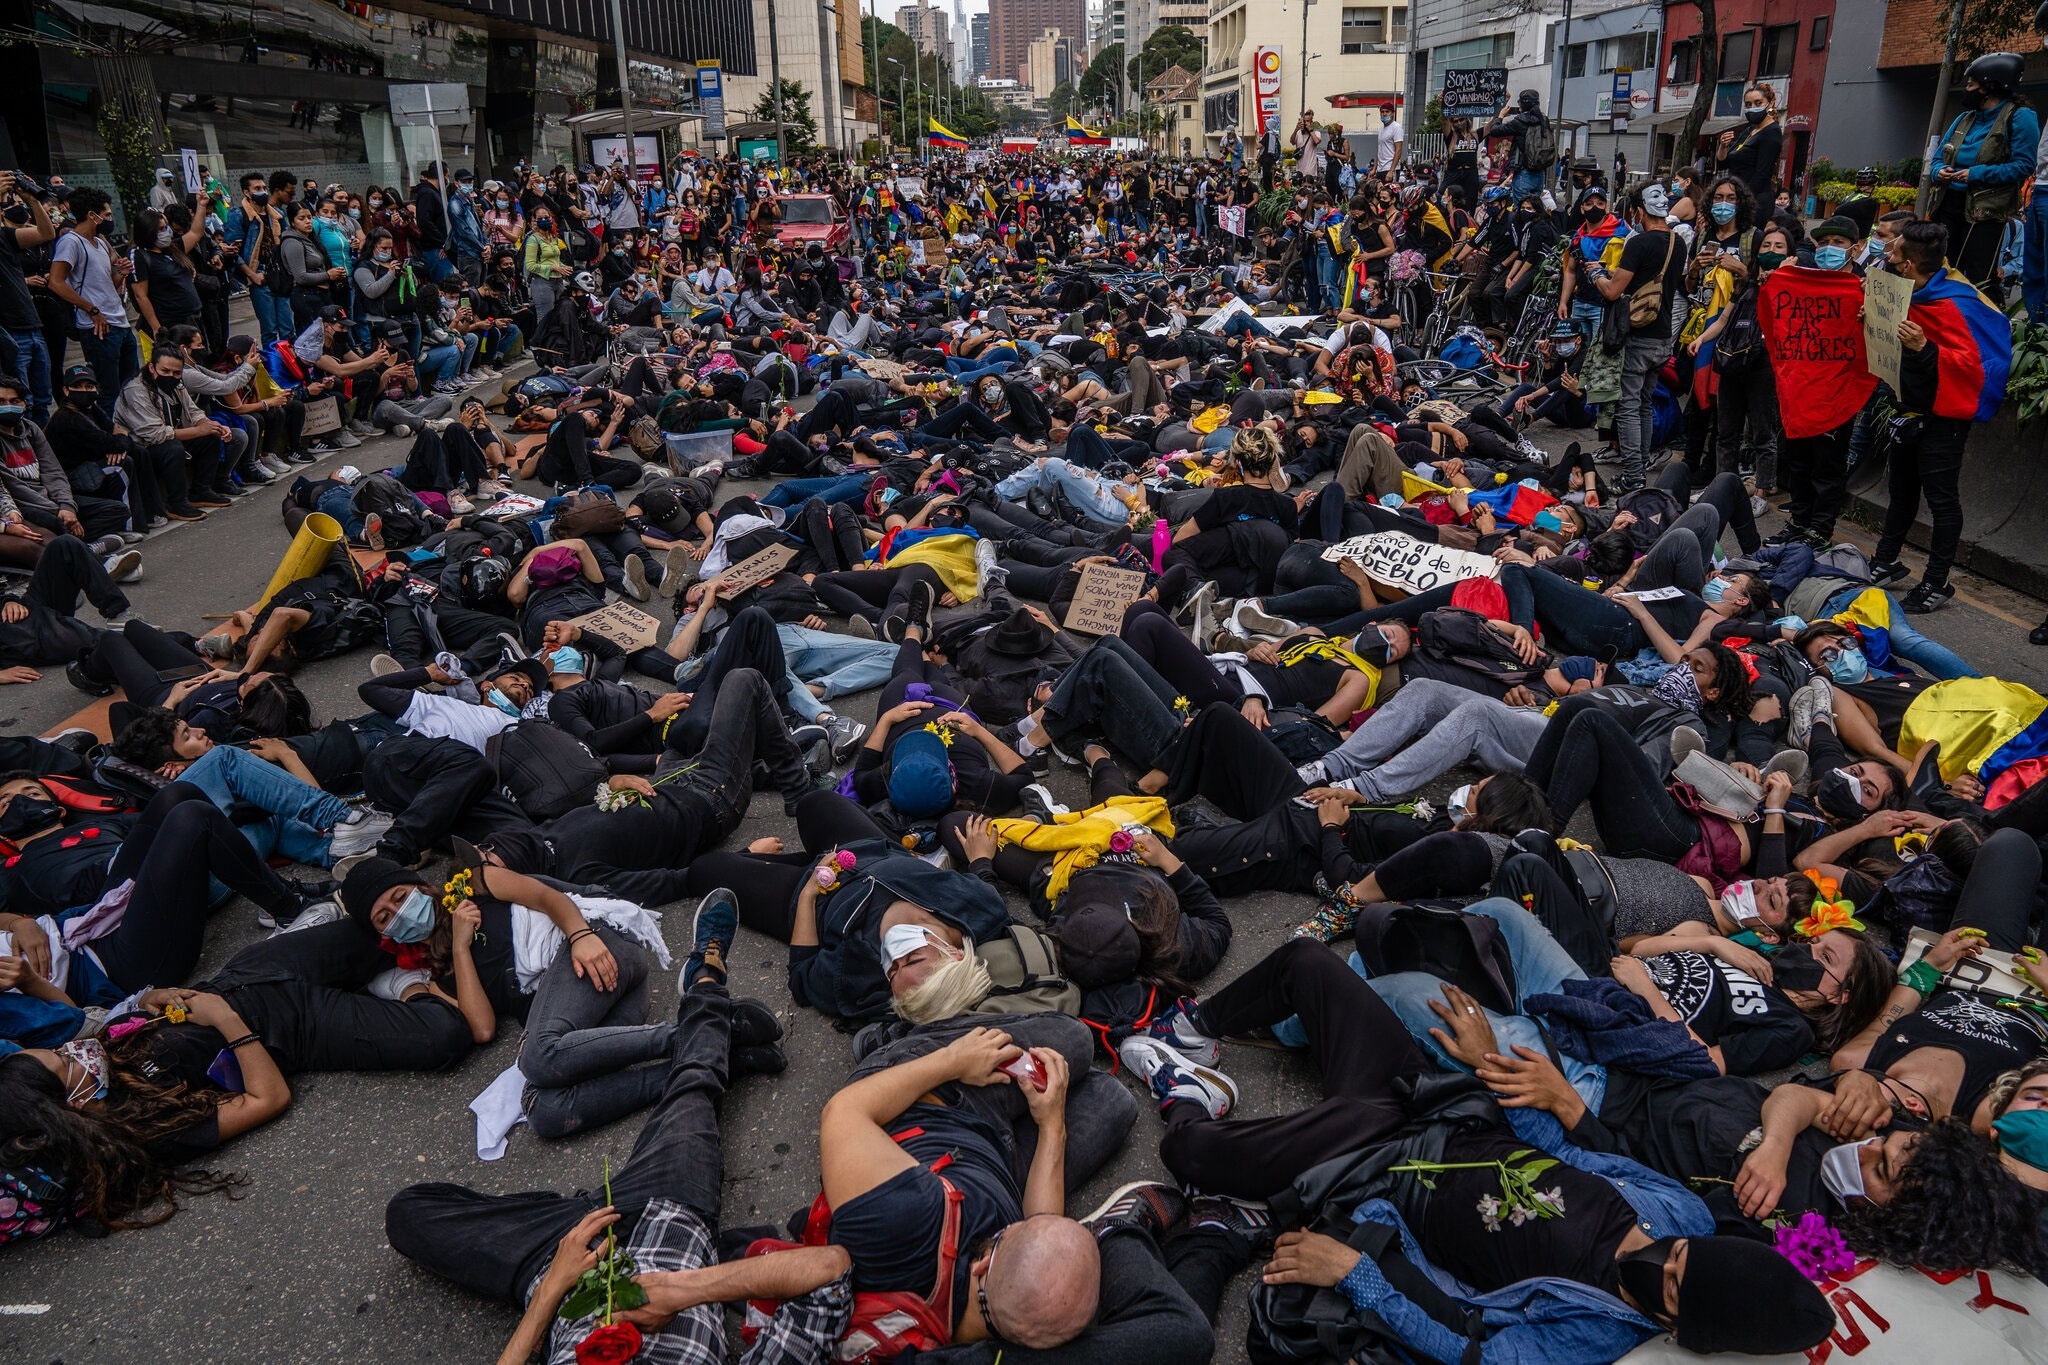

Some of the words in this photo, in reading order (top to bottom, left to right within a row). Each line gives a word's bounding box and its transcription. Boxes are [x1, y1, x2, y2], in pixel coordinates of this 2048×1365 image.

[1260, 77, 1278, 85] terpel
[1773, 290, 1842, 319] PAREN
[1786, 318, 1822, 340] LAS
[1428, 554, 1451, 573] de
[1087, 566, 1120, 580] VIENEN
[1124, 574, 1142, 583] QUE
[1352, 556, 1438, 590] UEBLO
[1090, 577, 1110, 586] LOS
[1115, 582, 1139, 591] PARA
[1085, 585, 1133, 601] ESTAMOS
[1079, 607, 1097, 617] LOS
[1093, 599, 1116, 611] QUE
[1102, 612, 1122, 623] POR
[1076, 618, 1119, 634] MARCHO
[1921, 1011, 1954, 1030] VIVAS
[1955, 1028, 2013, 1050] SIEMPRE
